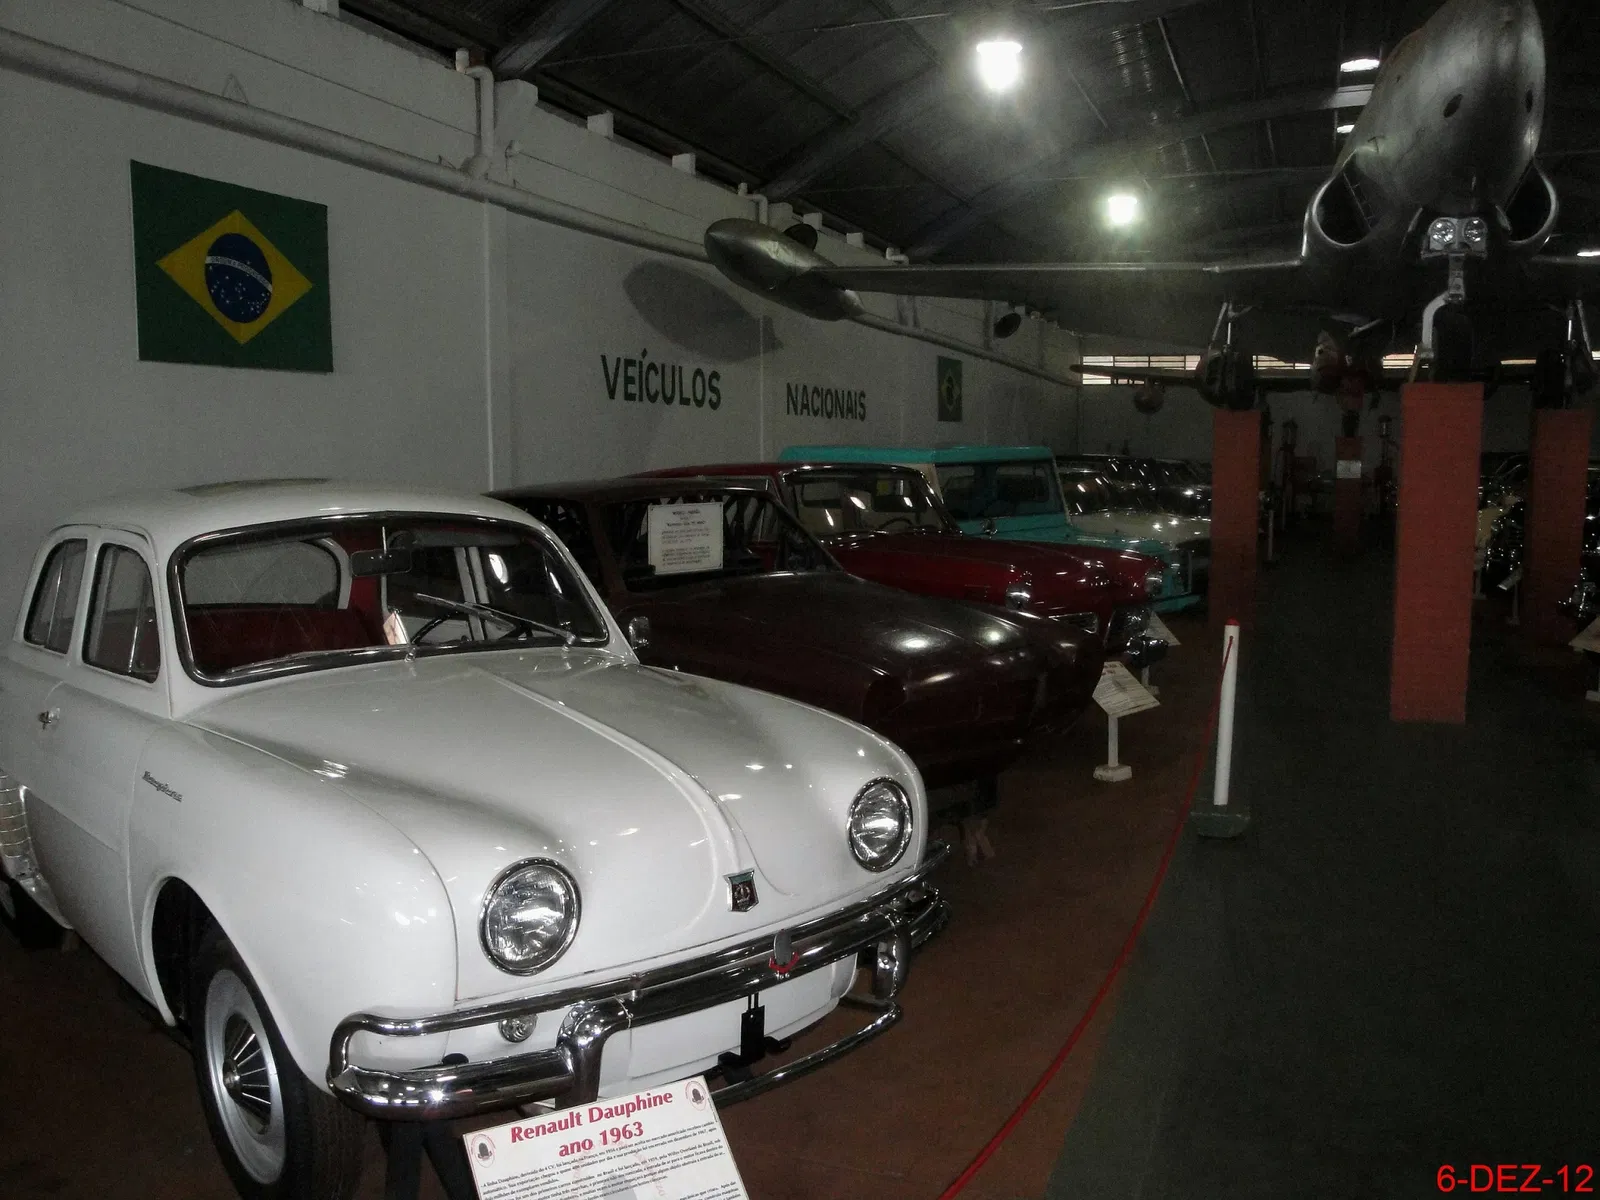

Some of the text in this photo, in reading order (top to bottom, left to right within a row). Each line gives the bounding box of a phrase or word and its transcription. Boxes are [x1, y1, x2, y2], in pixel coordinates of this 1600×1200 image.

[600, 347, 867, 422] VEÍCULOS NACIONAIS
[511, 1092, 673, 1143] Renault Dauphine
[558, 1121, 644, 1157] ano 1963
